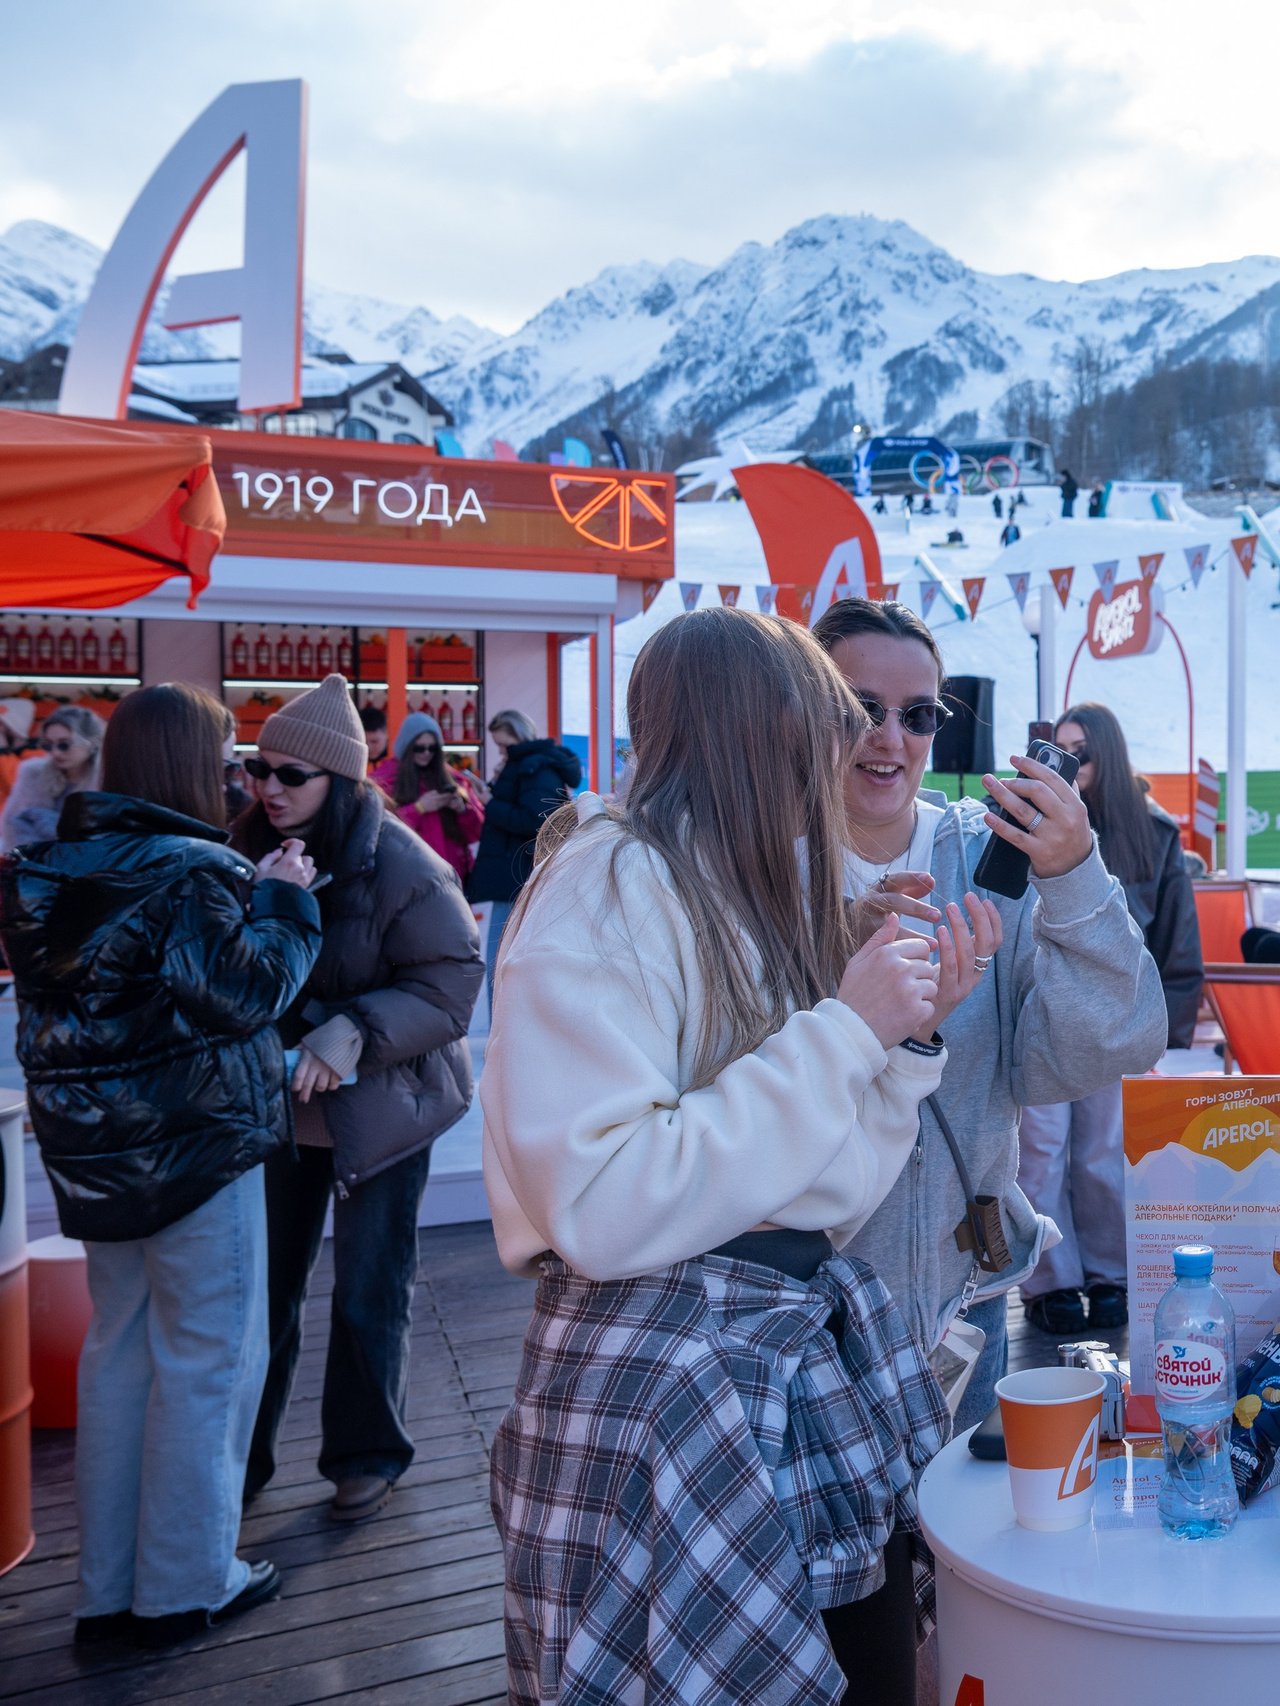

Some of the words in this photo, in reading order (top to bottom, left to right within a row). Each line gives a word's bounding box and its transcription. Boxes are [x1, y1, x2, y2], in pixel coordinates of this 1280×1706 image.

[58, 77, 308, 420] A
[232, 471, 334, 514] 1919
[352, 478, 487, 527] ГОДА
[1185, 1094, 1217, 1108] ГОРЫ
[1218, 1087, 1254, 1102] ЗОВУТ
[1202, 1118, 1275, 1151] APEROL
[1134, 1203, 1185, 1212] ЗАКАЗЫВАЙ
[1186, 1203, 1231, 1213] КОКТЕЙЛИ
[1134, 1213, 1190, 1221] АПЕРОЛЬНЫЕ
[1135, 1233, 1160, 1241] ЧЕХОЛ
[1160, 1233, 1176, 1241] ДЛЯ
[1136, 1272, 1152, 1280] ДЛЯ
[1062, 1412, 1100, 1496] A
